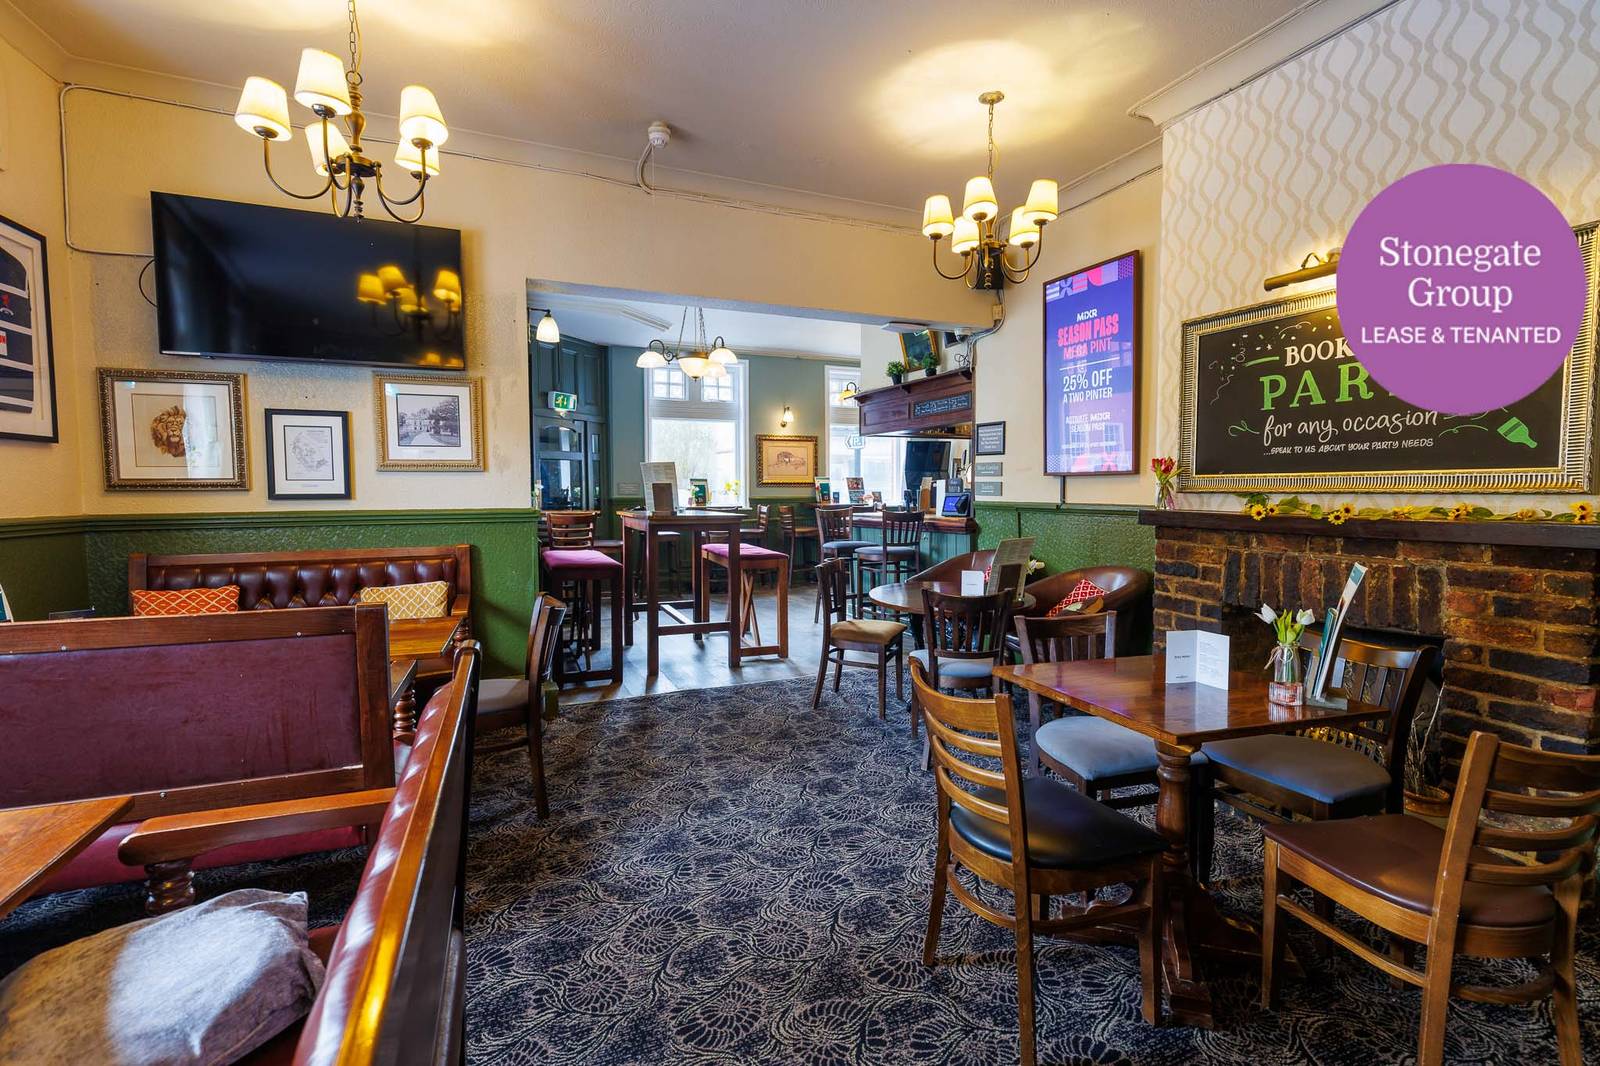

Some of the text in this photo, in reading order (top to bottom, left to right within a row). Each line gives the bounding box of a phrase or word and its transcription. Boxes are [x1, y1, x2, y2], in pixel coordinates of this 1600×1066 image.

[1057, 313, 1119, 347] SEASON PASS
[1090, 338, 1112, 354] PINT
[1063, 368, 1113, 392] 25% OFF
[1063, 387, 1113, 405] A TWO PINTER
[1263, 409, 1438, 446] for any occasion
[1294, 446, 1303, 454] TO
[1304, 445, 1316, 454] US
[1318, 443, 1346, 453] ABOUT
[1347, 442, 1370, 451] YOUR
[1371, 440, 1399, 450] PARTY
[1402, 438, 1434, 448] NEEDS
